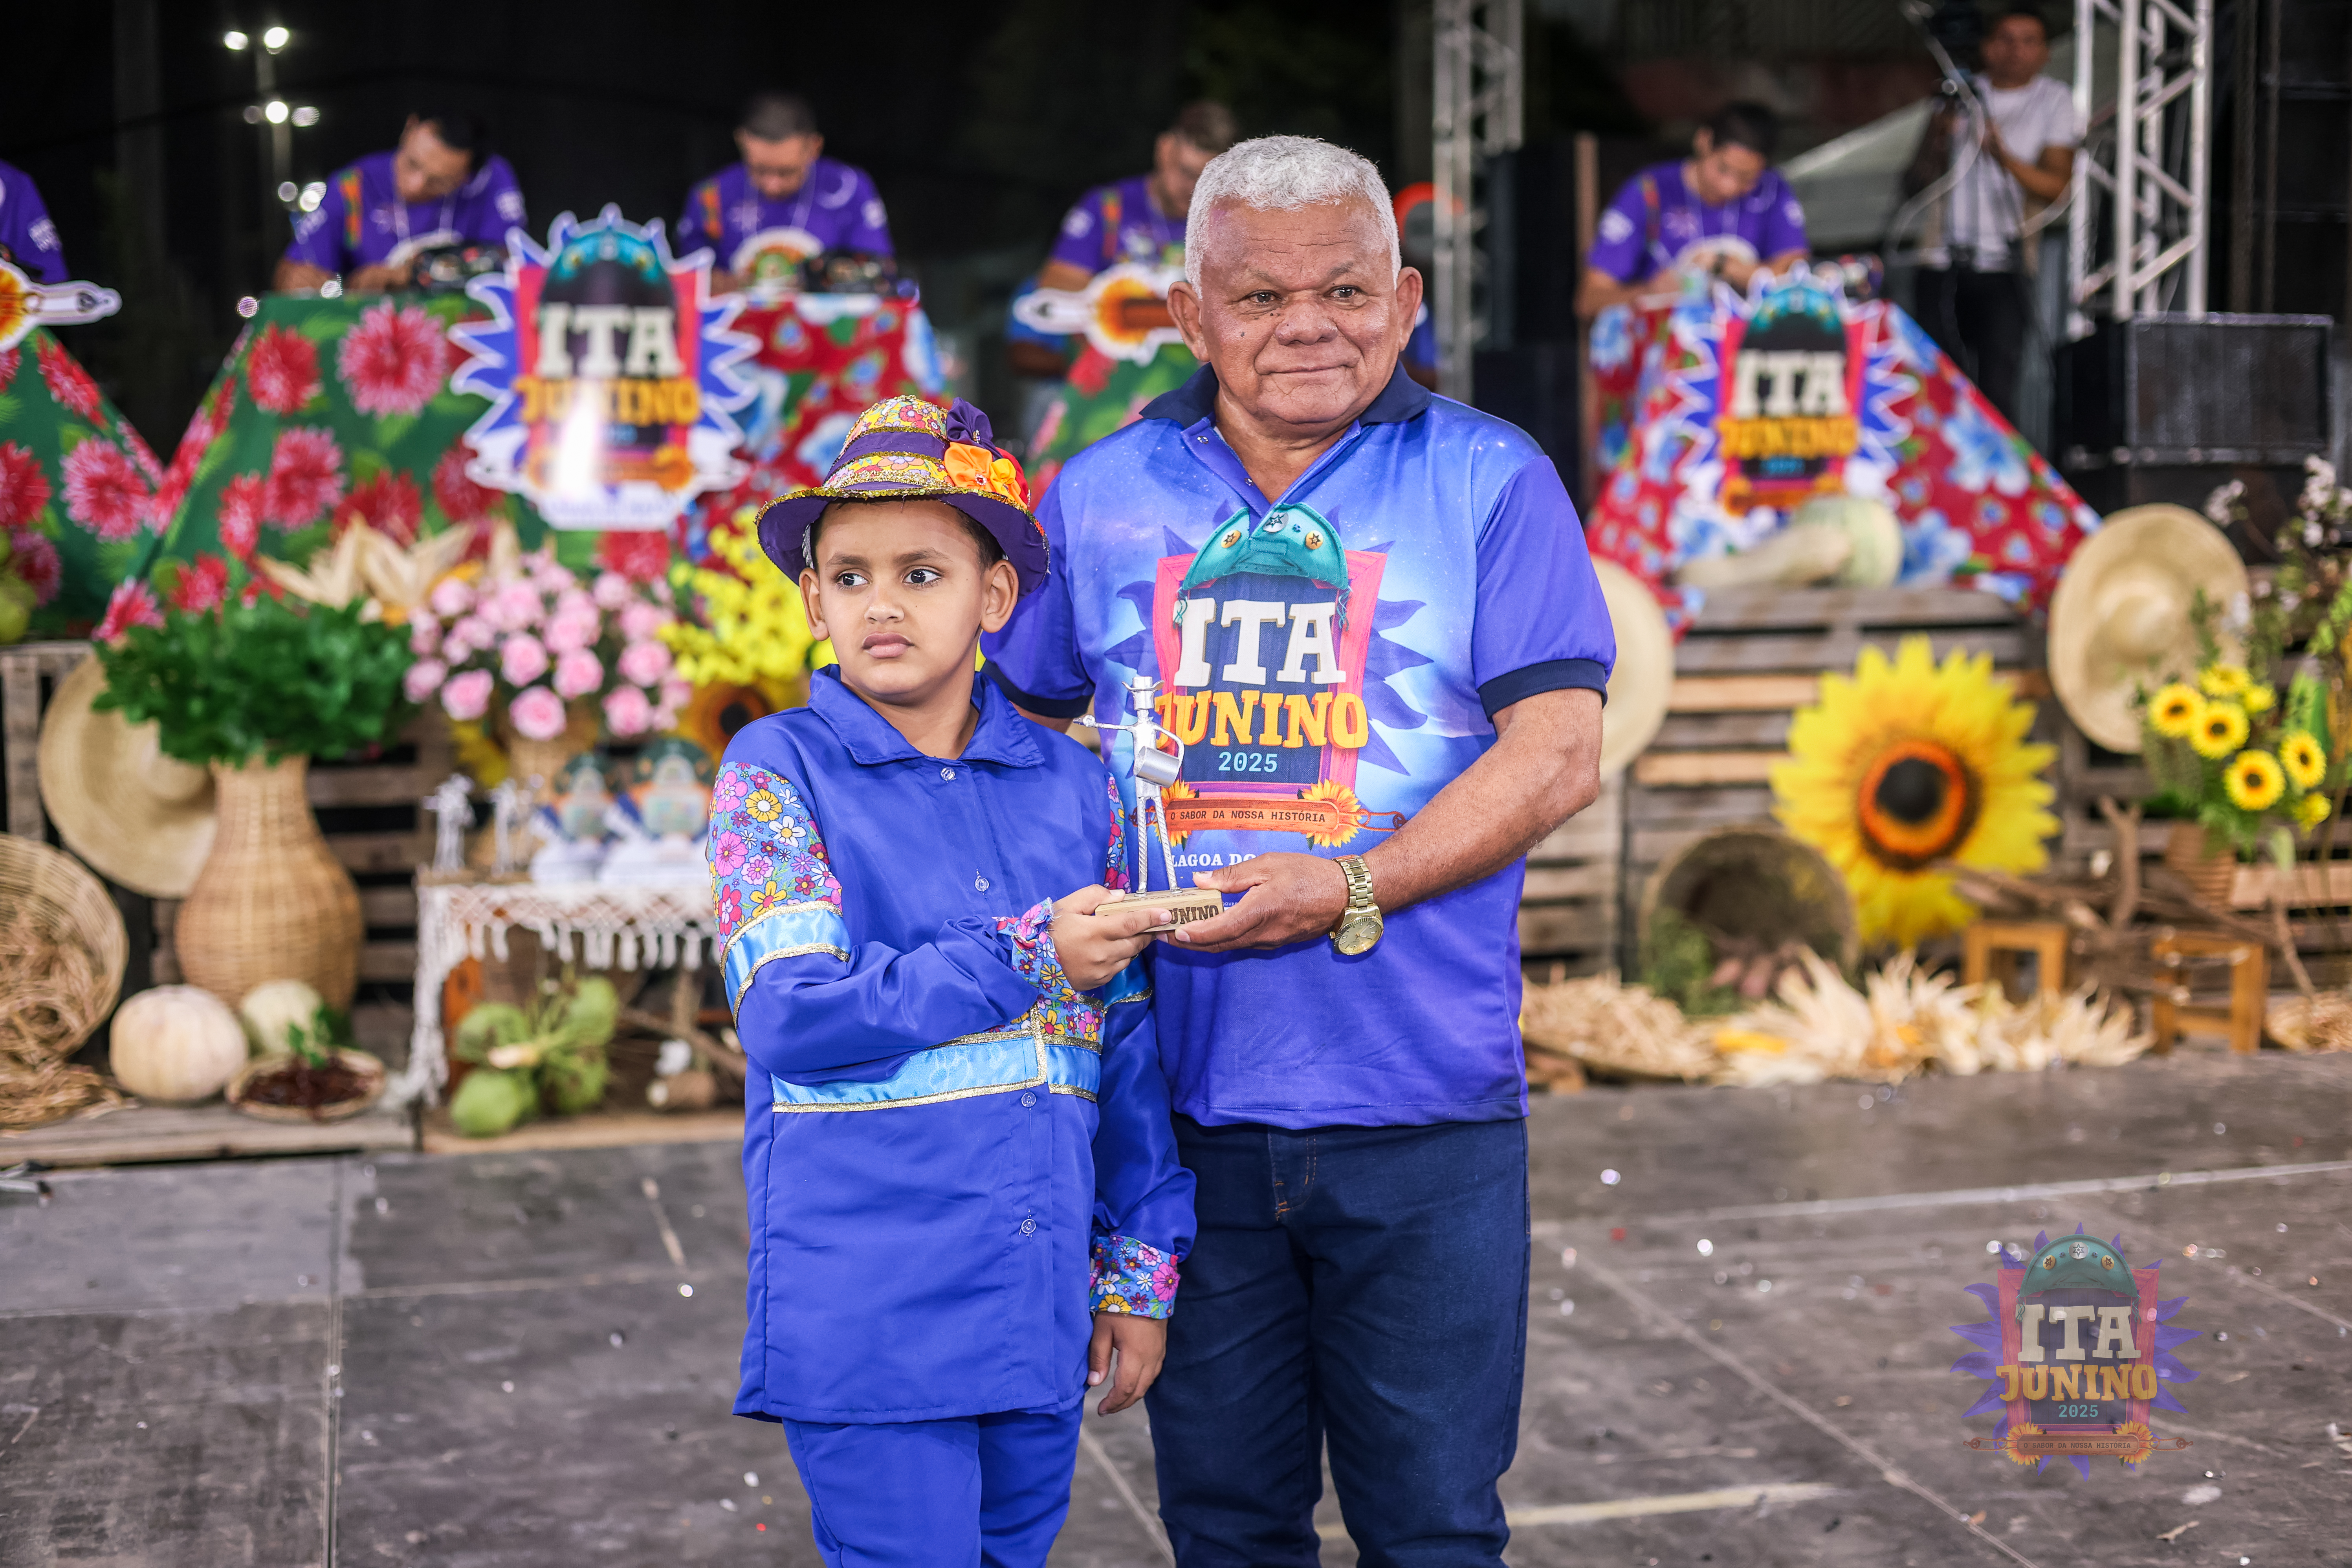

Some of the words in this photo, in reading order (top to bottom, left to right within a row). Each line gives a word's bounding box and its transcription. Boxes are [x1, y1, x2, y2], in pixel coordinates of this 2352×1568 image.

[537, 303, 684, 378] ITA
[513, 376, 701, 425] JUINO
[1733, 350, 1851, 416] ITA
[1173, 598, 1346, 687] ITA
[1154, 690, 1369, 748] JUNINO
[1219, 751, 1278, 772] 2025
[1170, 812, 1175, 820] O
[1180, 811, 1206, 820] SABOR
[1213, 810, 1225, 819] DA
[1231, 810, 1264, 820] NOSSA
[1271, 811, 1325, 822] HISTÓRIA
[1171, 853, 1224, 867] LAGOA
[1169, 905, 1219, 924] UNINO
